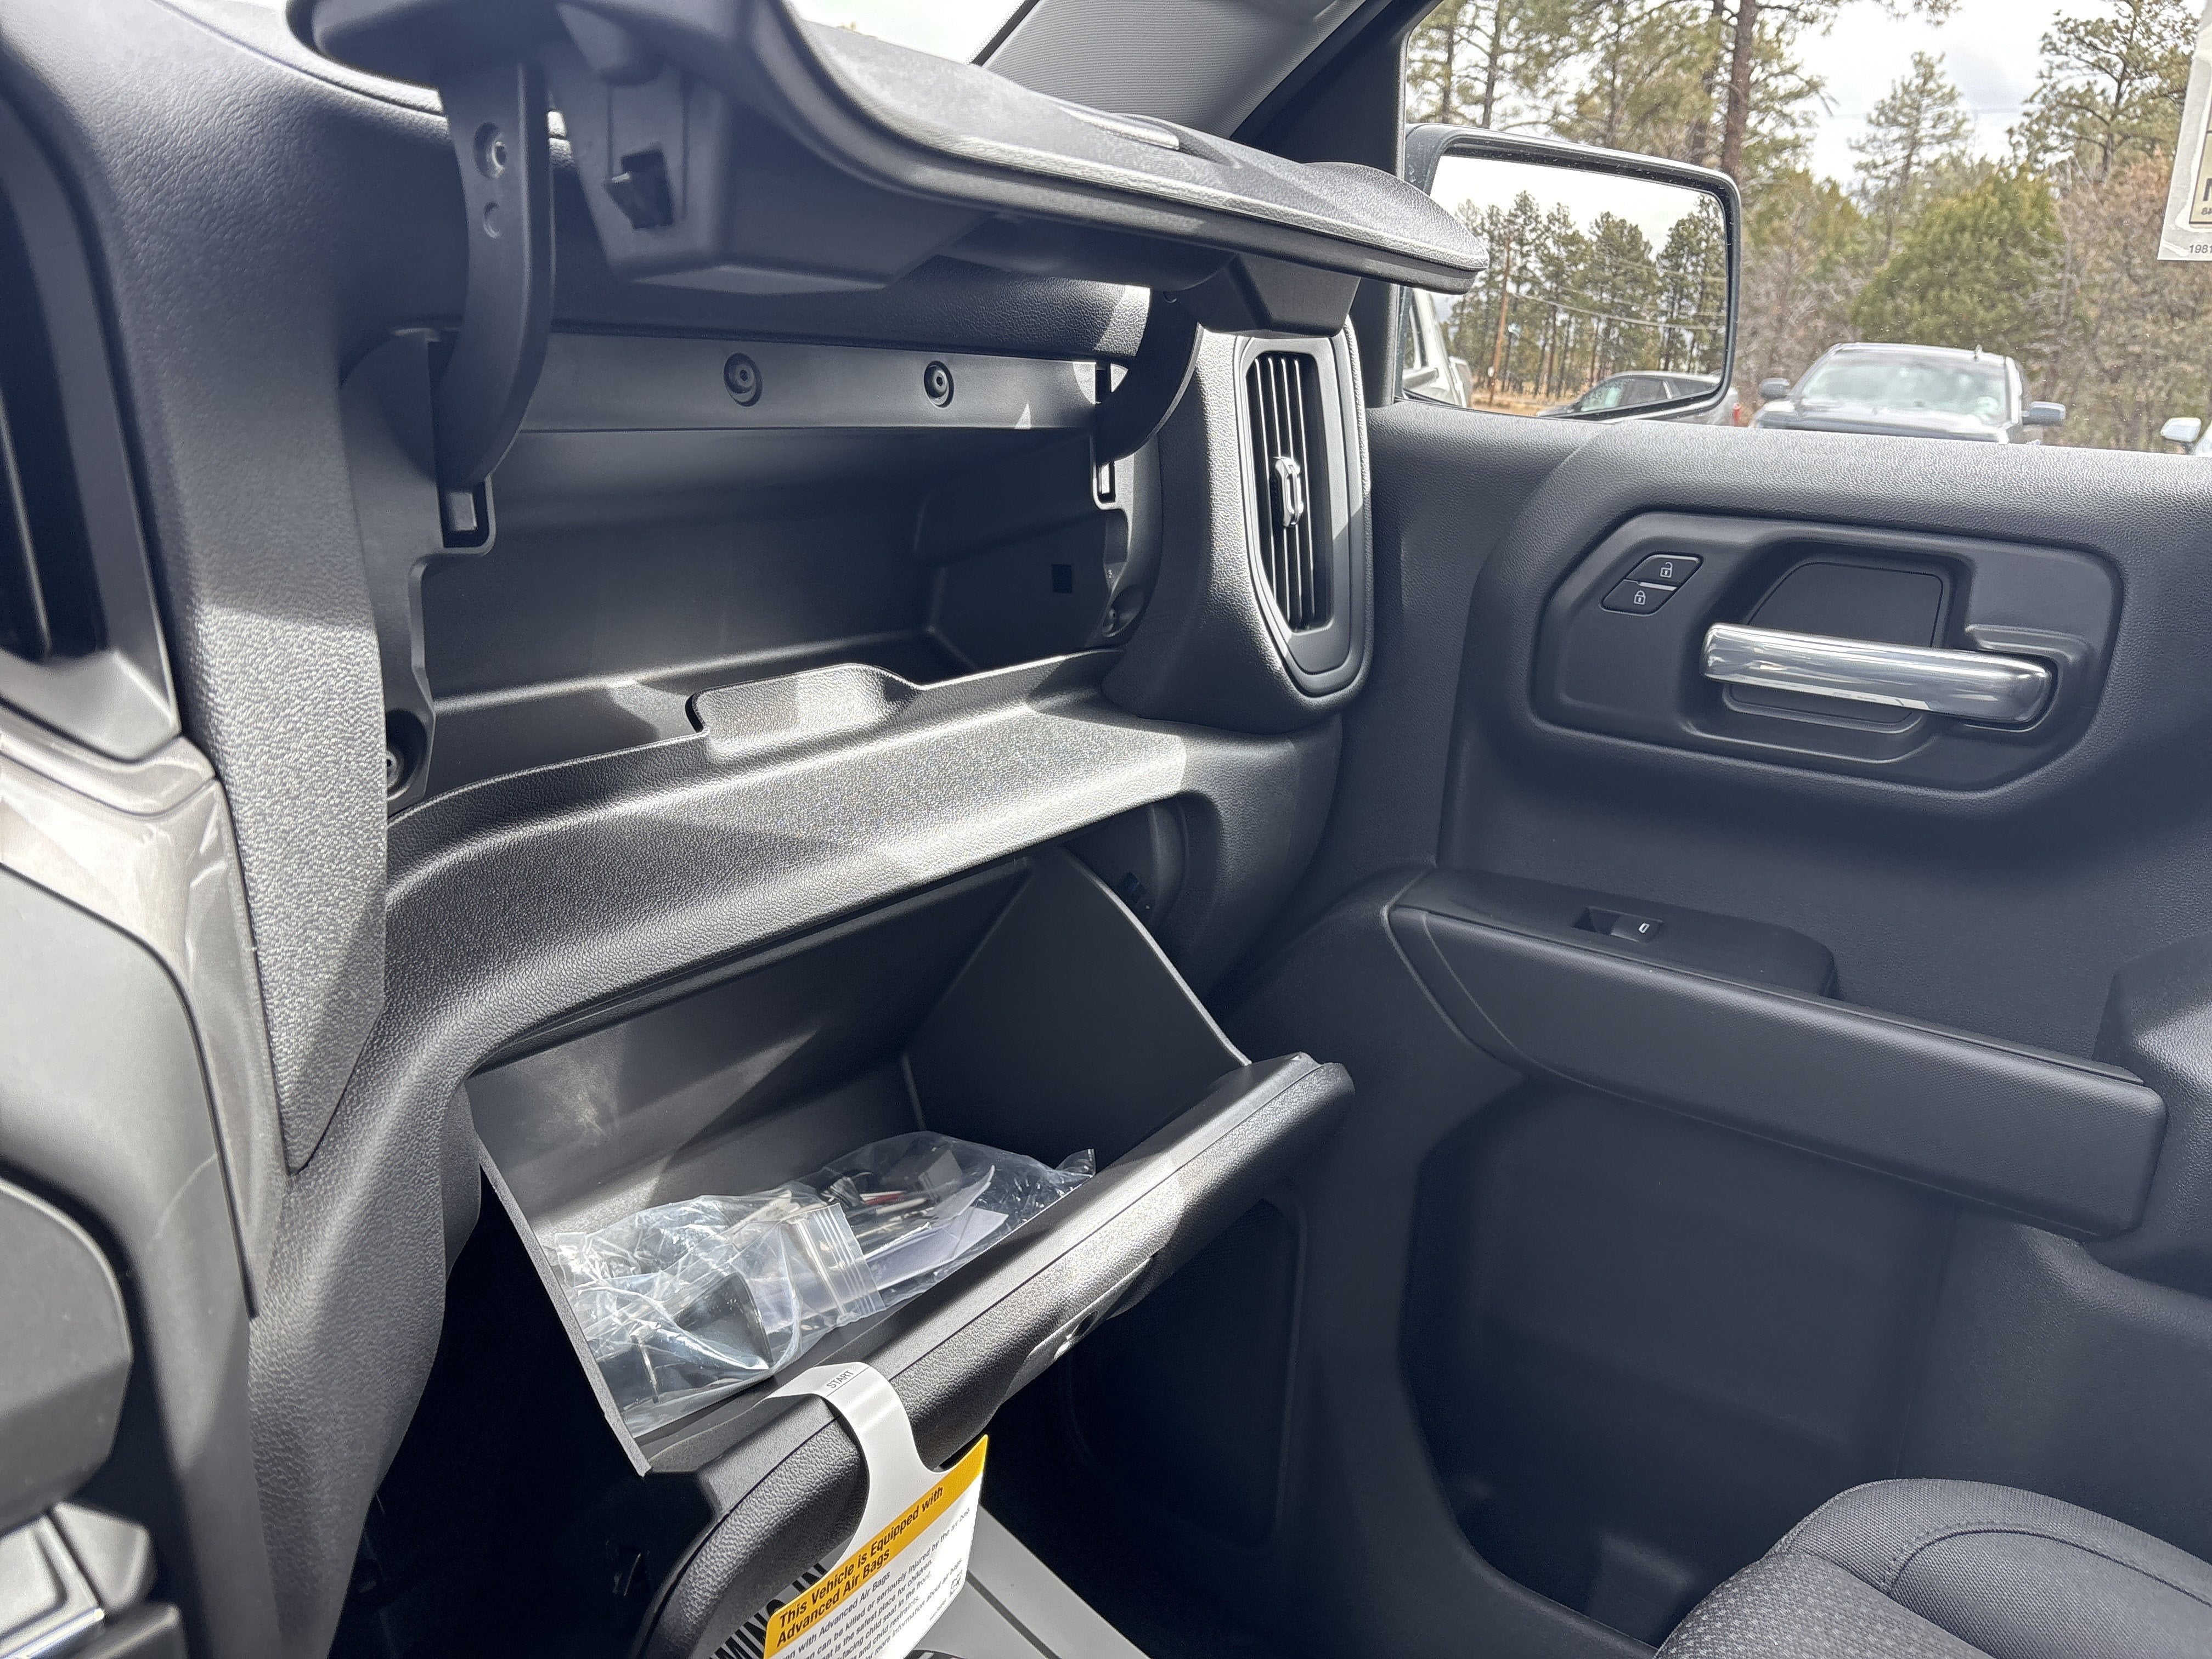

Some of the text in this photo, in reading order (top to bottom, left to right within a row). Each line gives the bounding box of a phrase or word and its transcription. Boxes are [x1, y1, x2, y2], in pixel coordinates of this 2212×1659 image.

[826, 1370, 854, 1389] START
[779, 1600, 808, 1629] This
[811, 1563, 855, 1606] Vehicle
[857, 1552, 867, 1569] is
[870, 1504, 919, 1558] Equipped
[922, 1486, 943, 1513] with
[817, 1638, 832, 1655] can
[834, 1630, 844, 1640] be
[845, 1608, 865, 1631] killed
[867, 1600, 876, 1612] or
[876, 1571, 907, 1604] seriously
[908, 1547, 930, 1575] injured
[932, 1539, 940, 1551] by
[940, 1529, 950, 1543] the
[776, 1588, 840, 1648] Advanced
[842, 1573, 860, 1598] Air
[862, 1548, 890, 1580] Bags
[798, 1633, 817, 1654] with
[819, 1598, 859, 1638] Advanced
[859, 1590, 870, 1604] Air
[872, 1571, 890, 1592] Bags
[834, 1643, 842, 1654] is
[843, 1632, 854, 1646] the
[856, 1612, 877, 1635] safest
[878, 1594, 896, 1617] place
[897, 1583, 907, 1597] for
[865, 1618, 882, 1639] child
[883, 1604, 897, 1622] seat
[898, 1599, 904, 1609] in
[905, 1587, 916, 1601] the
[874, 1635, 891, 1656] more
[892, 1600, 925, 1638] information
[858, 1640, 872, 1658] and
[873, 1623, 889, 1645] child
